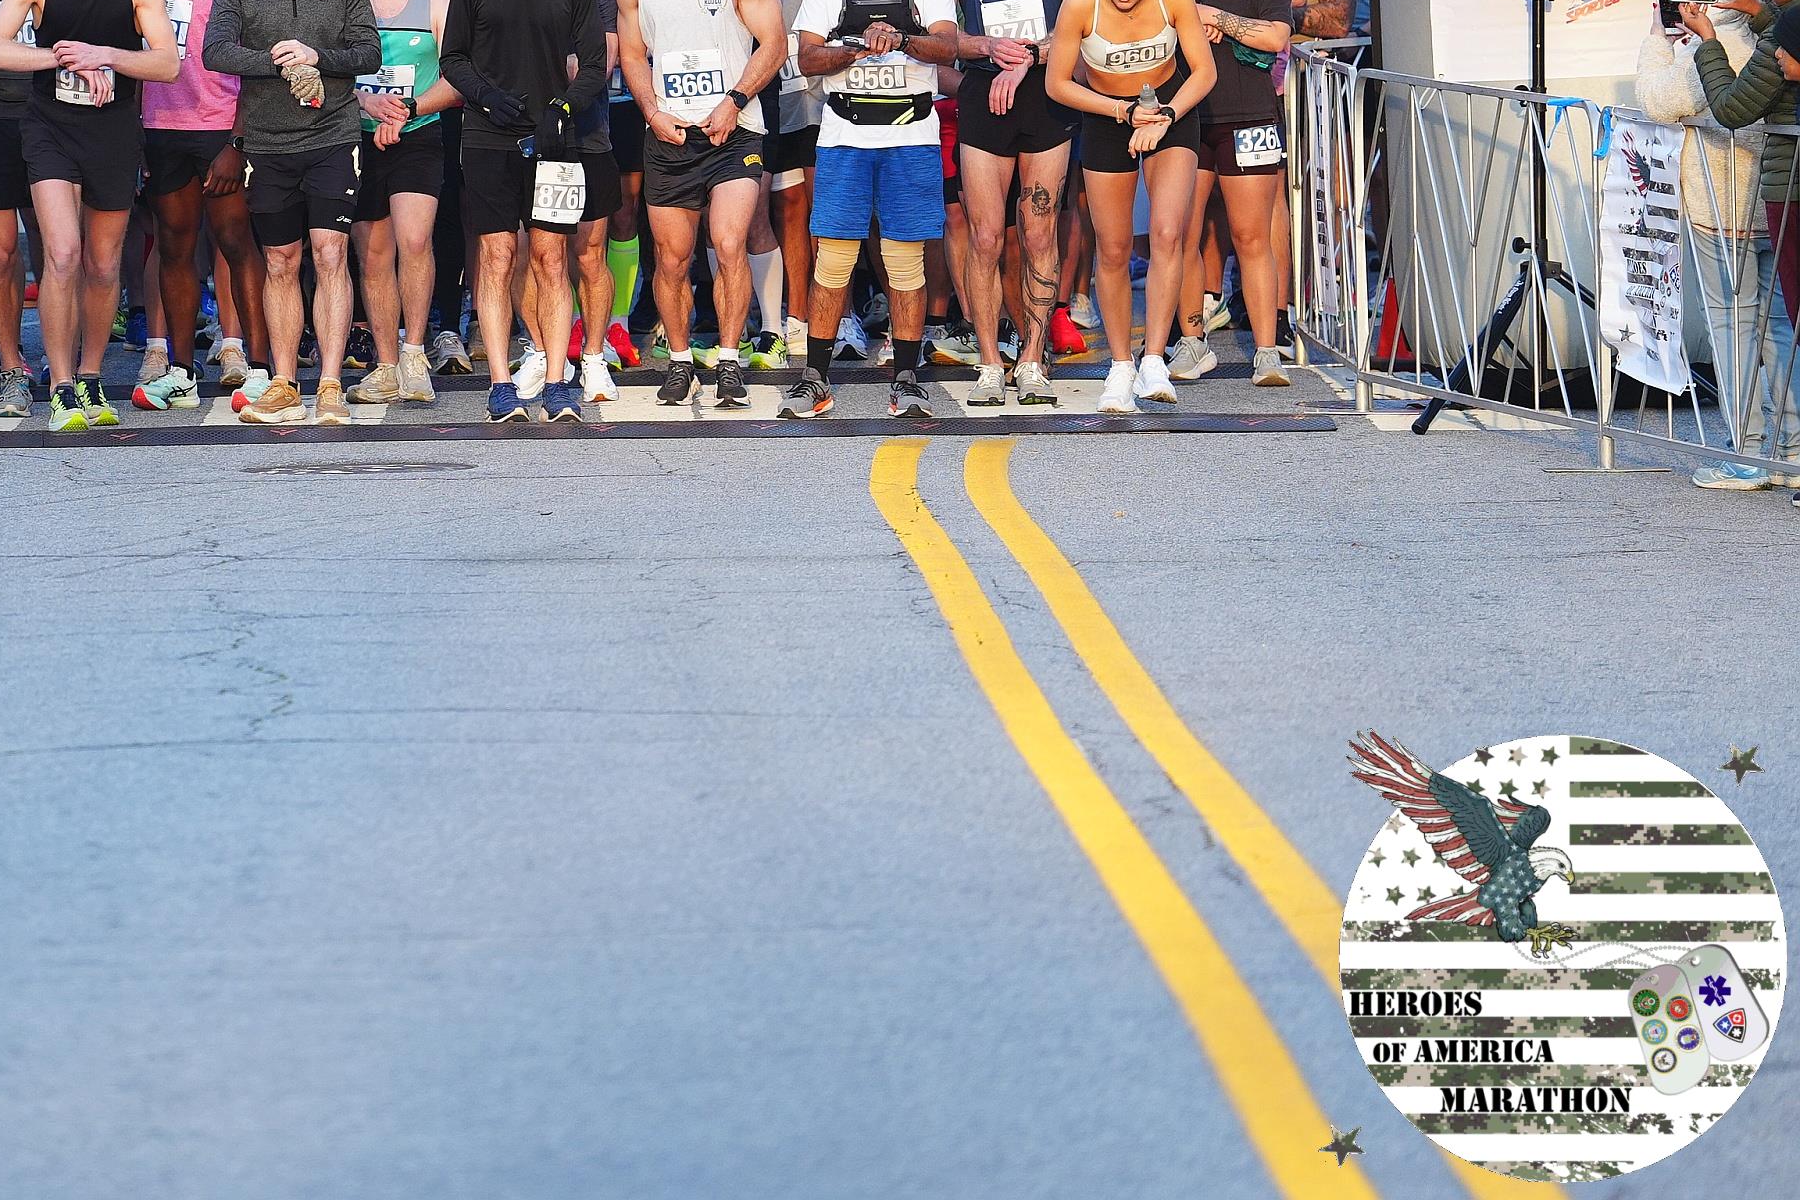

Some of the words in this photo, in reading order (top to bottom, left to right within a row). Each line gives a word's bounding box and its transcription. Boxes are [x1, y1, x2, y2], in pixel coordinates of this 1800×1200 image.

[1110, 46, 1156, 66] 960
[667, 72, 712, 98] 366
[849, 66, 895, 91] 956
[1237, 127, 1277, 152] 326
[537, 185, 580, 210] 876
